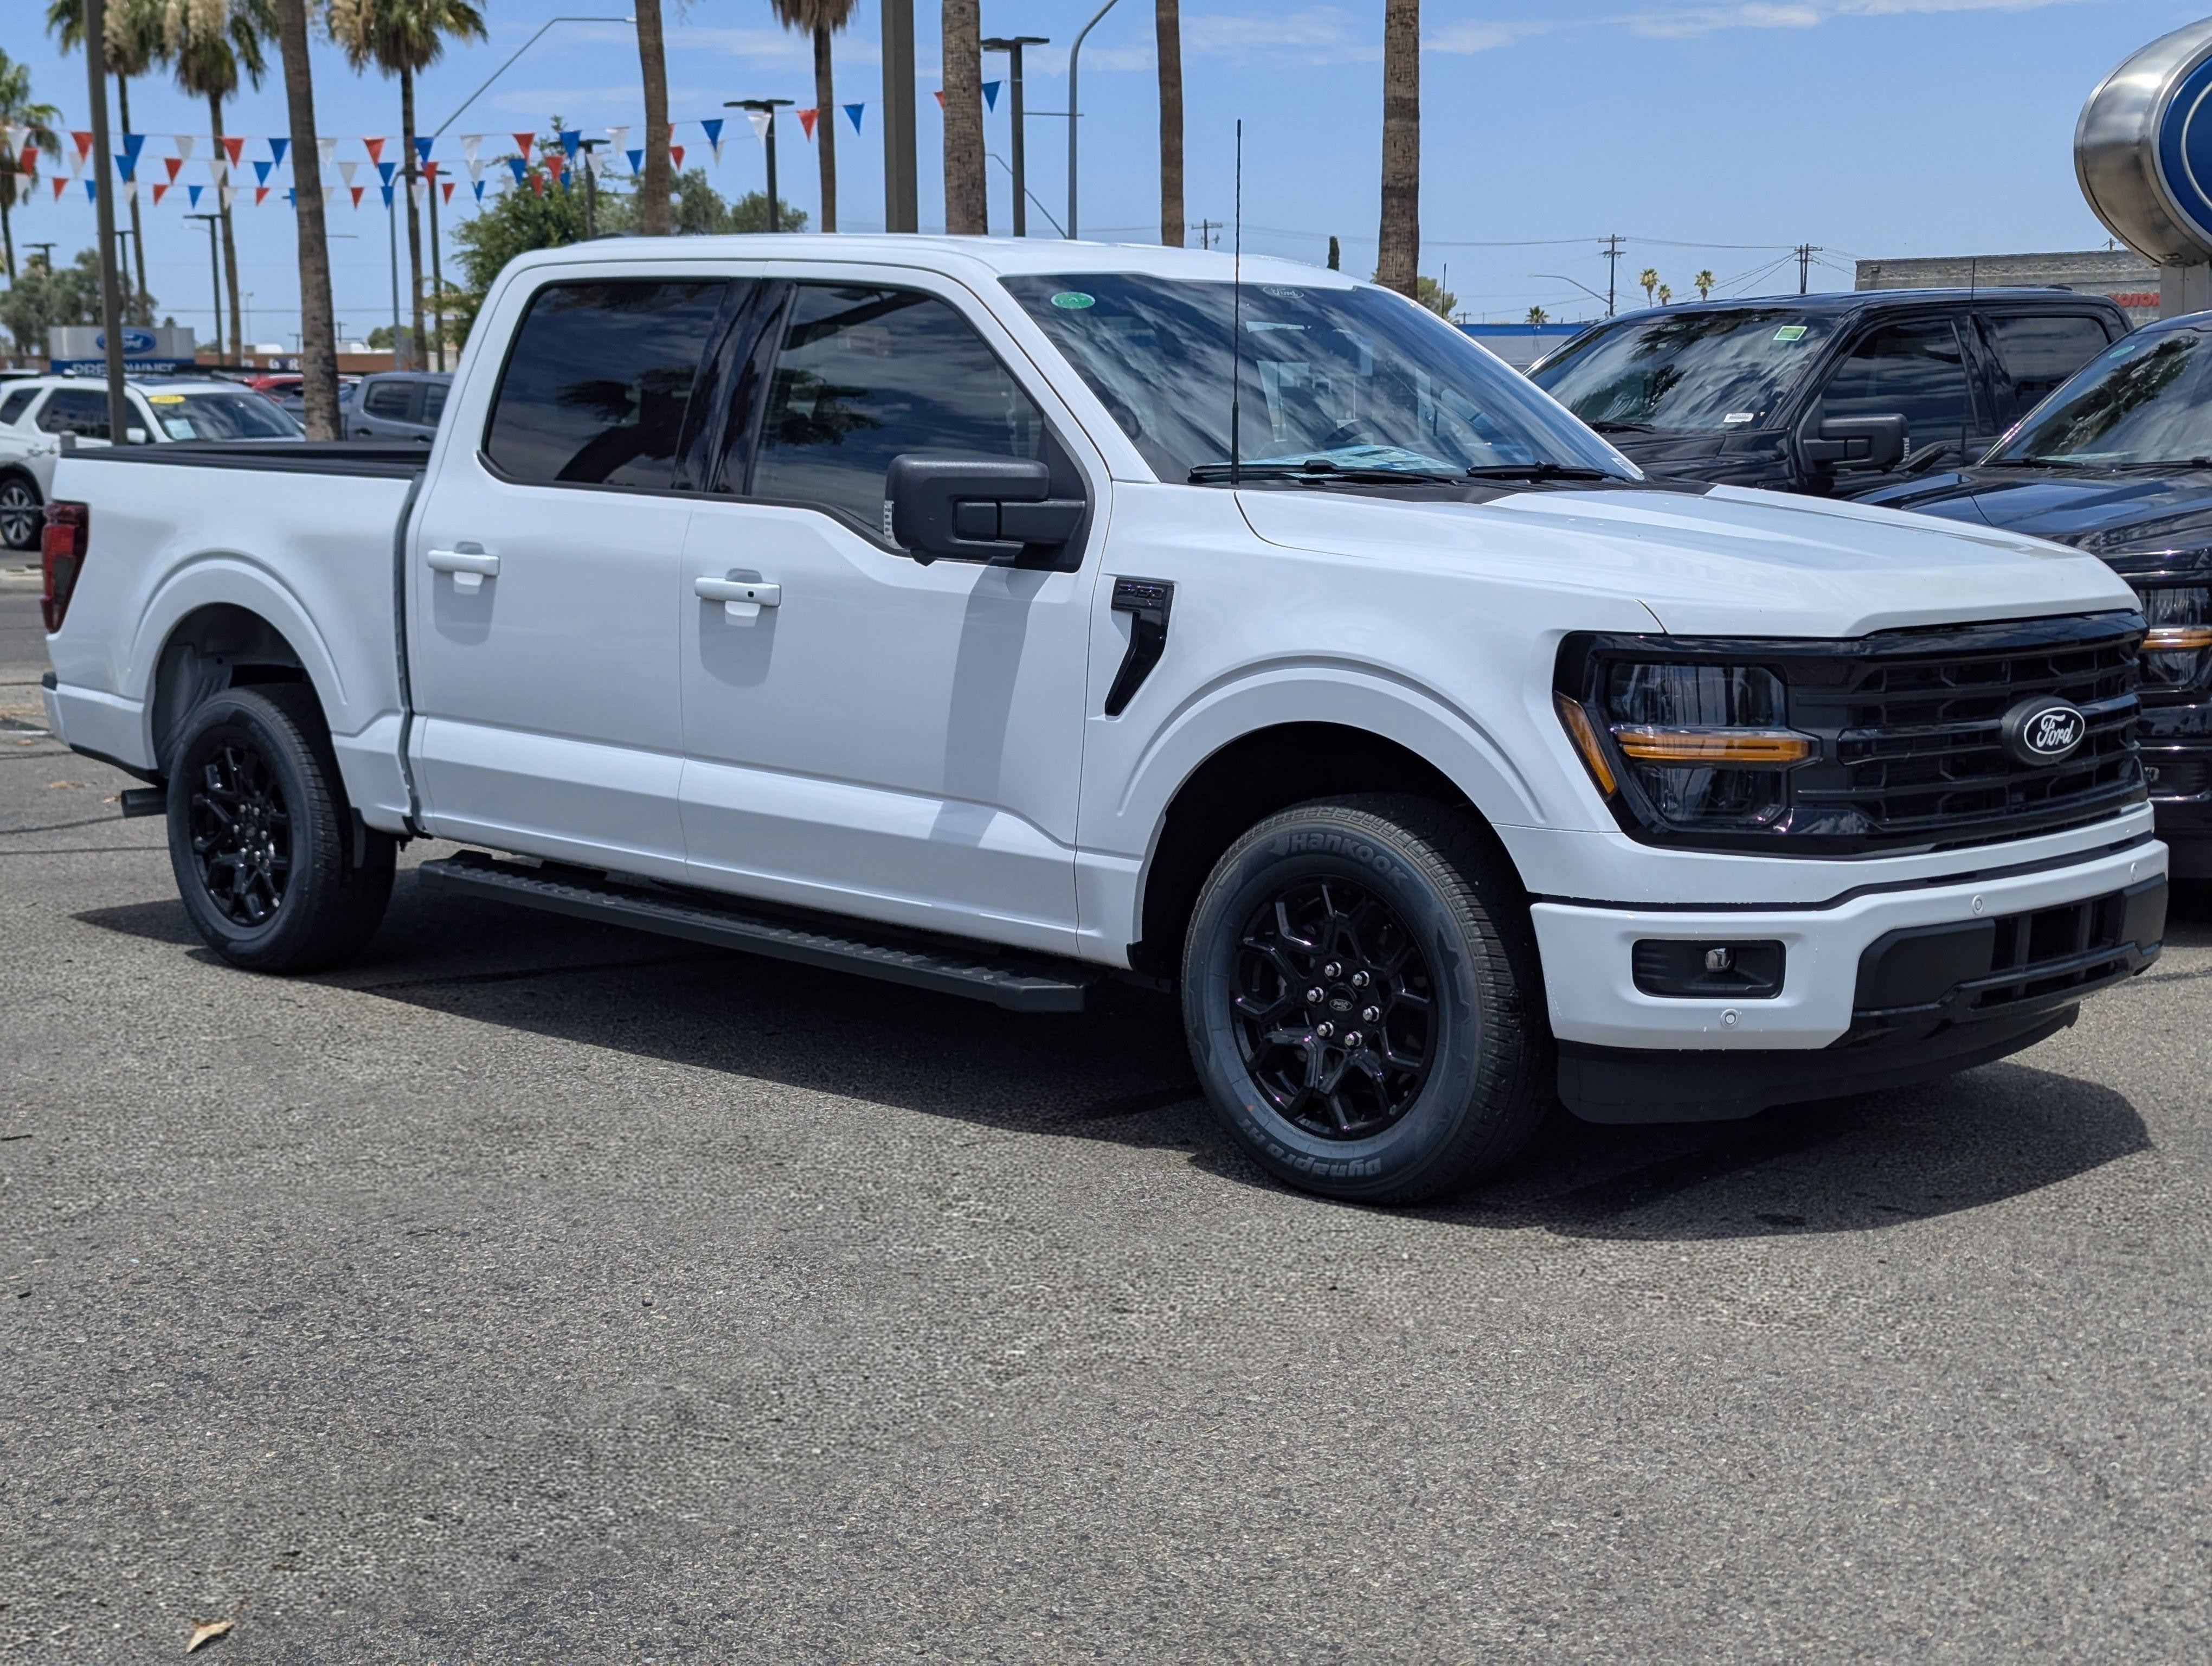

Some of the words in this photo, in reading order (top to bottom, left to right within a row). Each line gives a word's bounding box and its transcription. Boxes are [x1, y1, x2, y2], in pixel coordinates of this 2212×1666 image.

[2112, 293, 2160, 307] OTOR
[121, 335, 143, 348] ord
[2036, 714, 2075, 747] Ford
